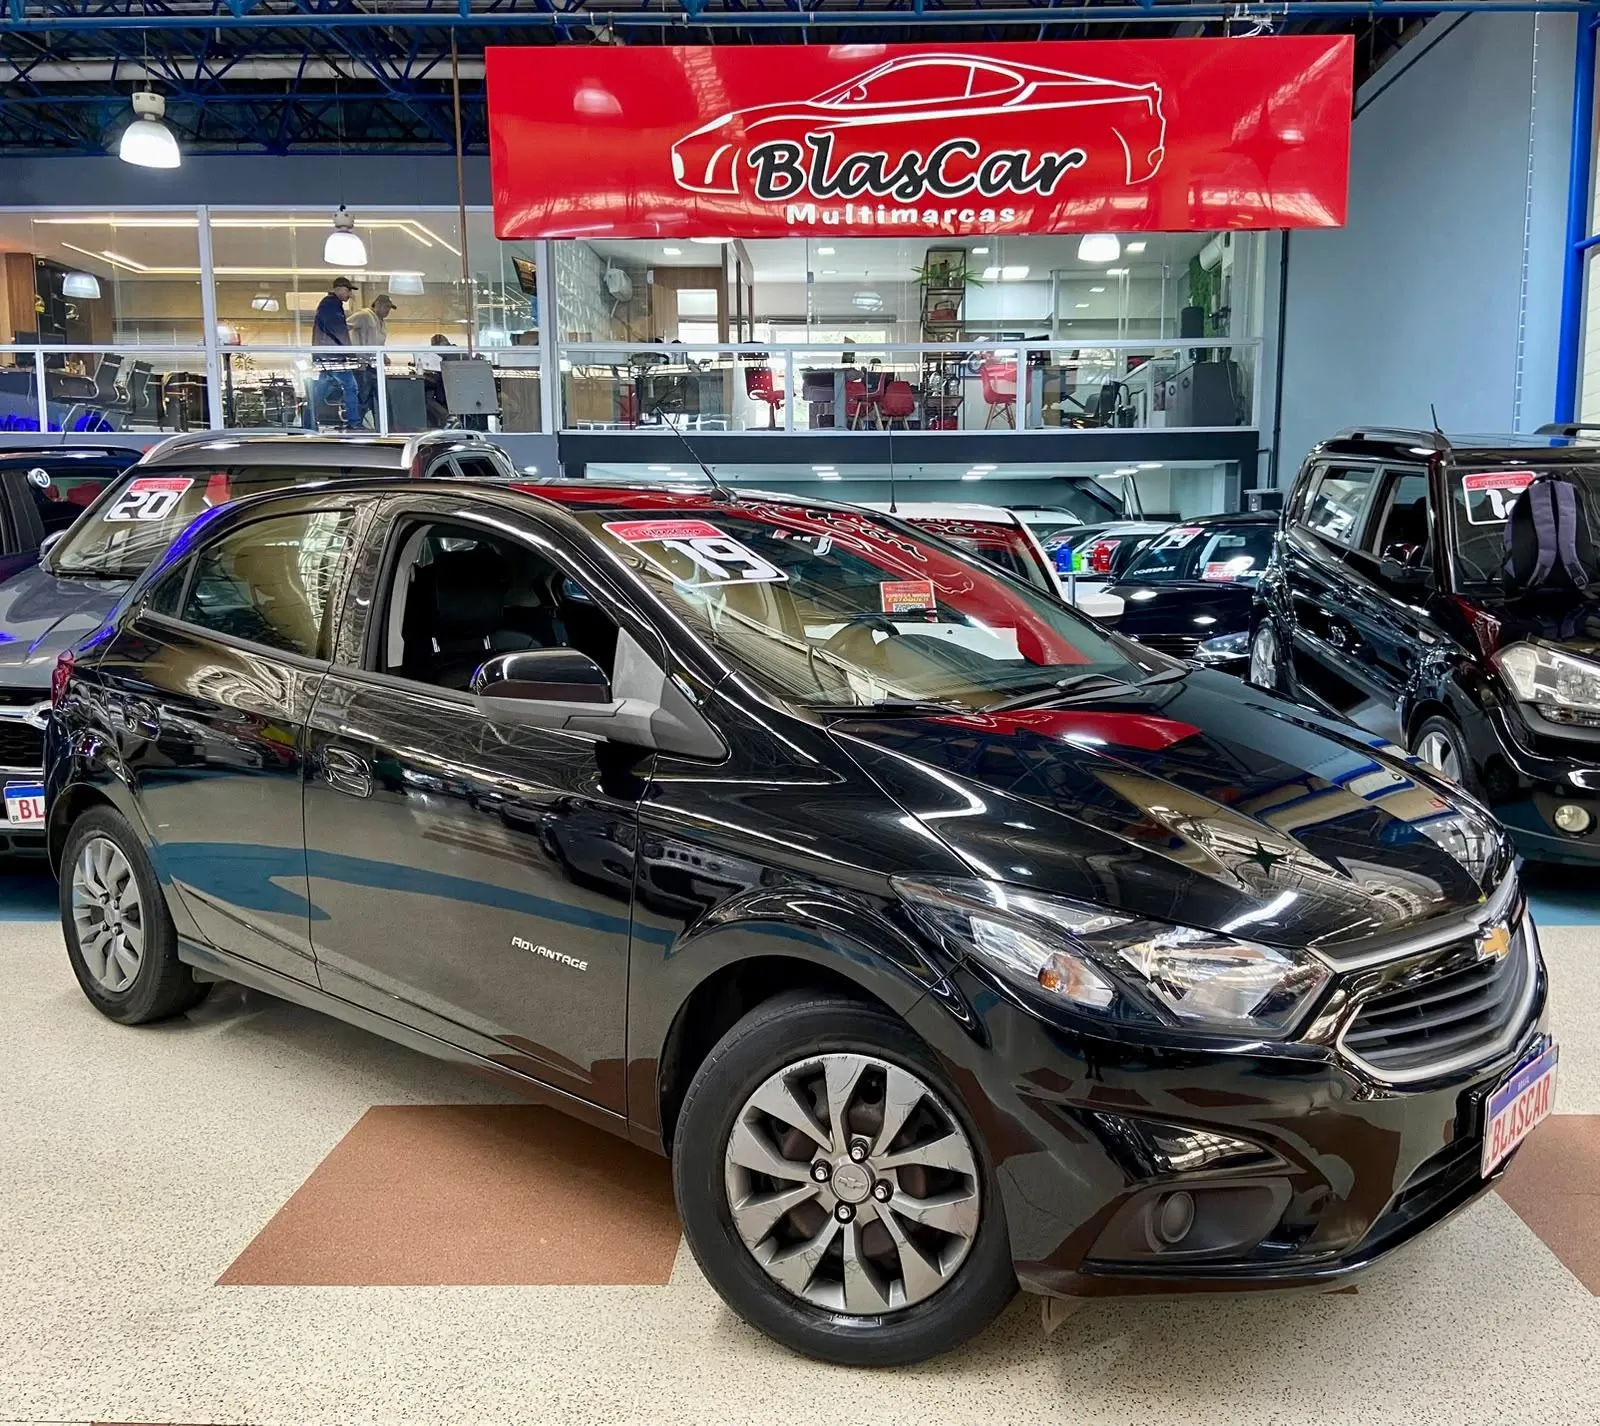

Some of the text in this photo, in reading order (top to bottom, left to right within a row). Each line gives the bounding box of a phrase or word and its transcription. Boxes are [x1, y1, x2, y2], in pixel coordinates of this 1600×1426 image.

[748, 132, 1086, 203] BlasCar
[786, 203, 1017, 225] Multimarcas
[109, 490, 179, 519] 20
[661, 538, 778, 580] 19
[18, 798, 47, 820] BL
[511, 936, 588, 971] ADVANTAGE
[1491, 1073, 1551, 1161] BLASCAR
